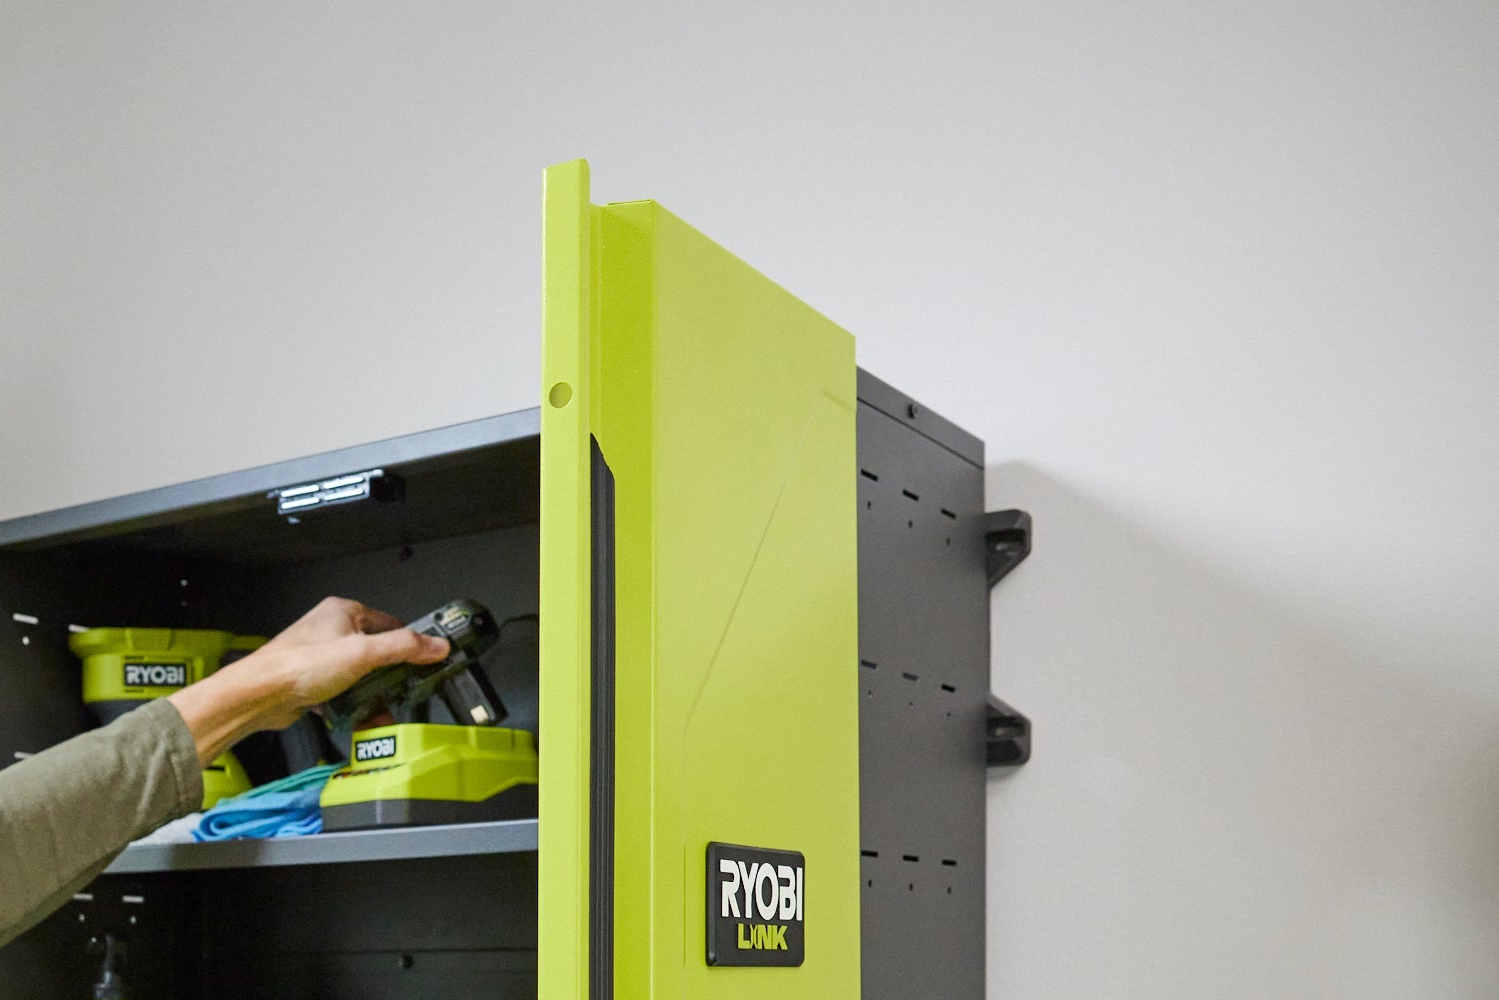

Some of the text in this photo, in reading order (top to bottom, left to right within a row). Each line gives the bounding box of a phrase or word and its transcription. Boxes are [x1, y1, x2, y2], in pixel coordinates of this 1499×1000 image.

[125, 664, 185, 684] RYOBI
[356, 737, 395, 760] RYOBI
[719, 858, 804, 922] RYOBI
[737, 922, 789, 951] LINK
